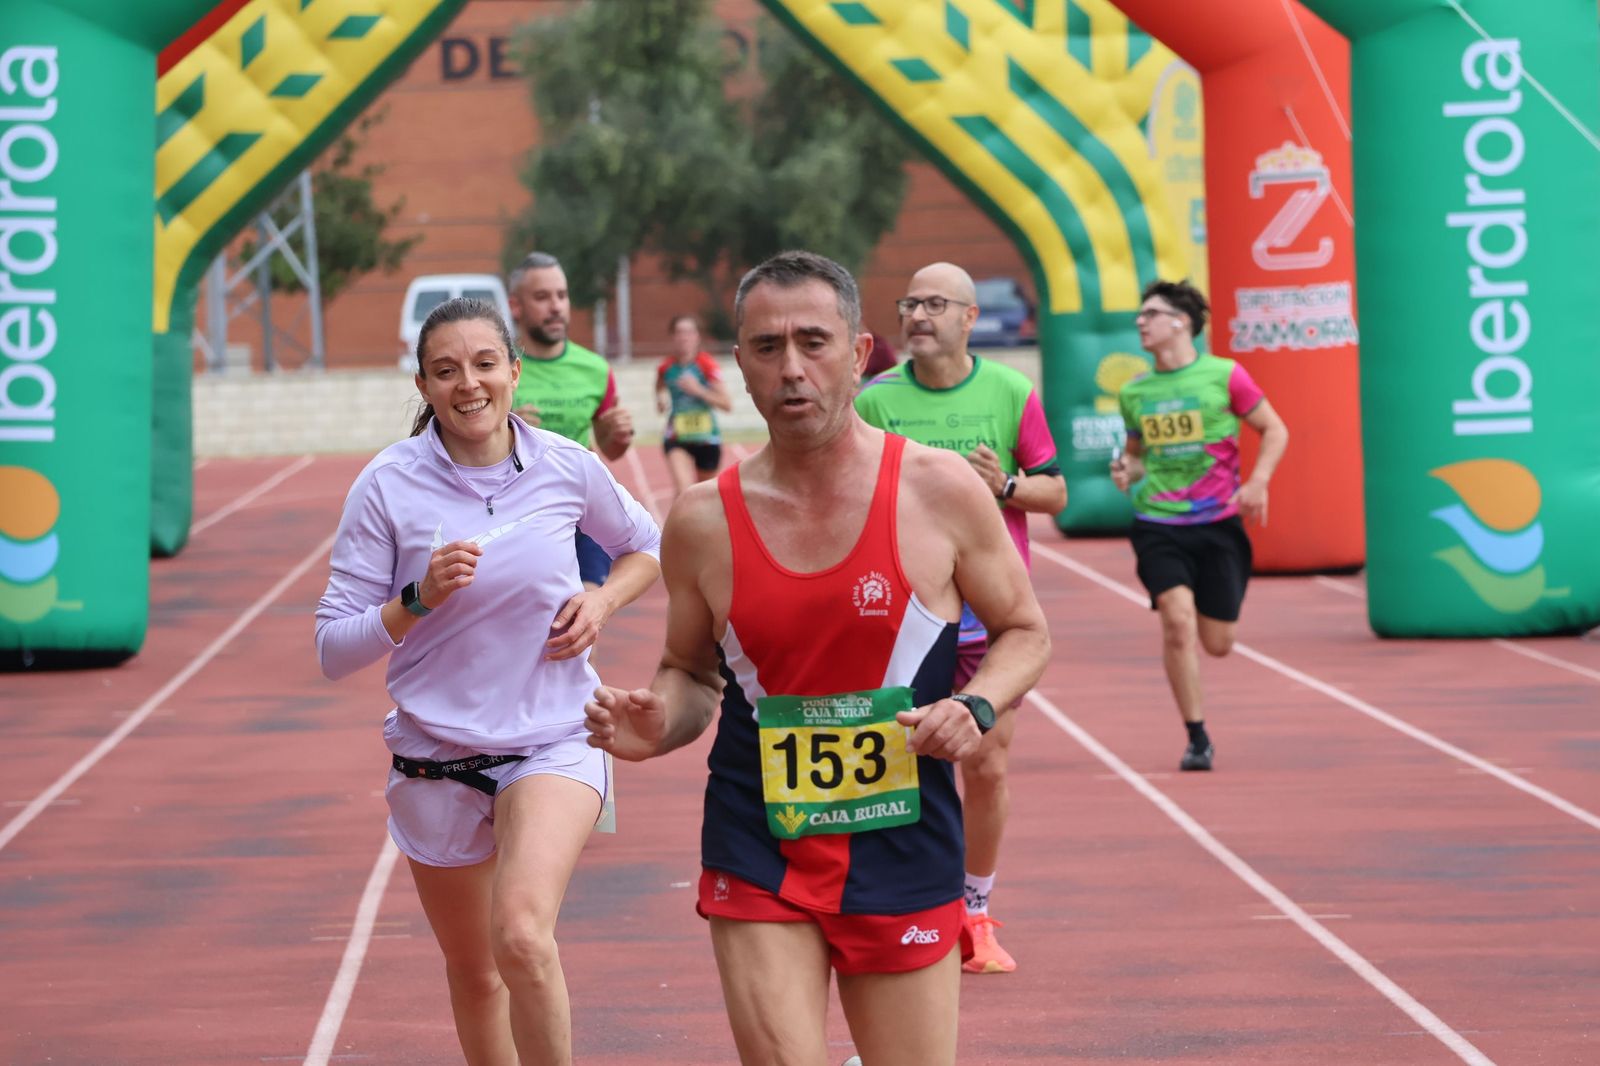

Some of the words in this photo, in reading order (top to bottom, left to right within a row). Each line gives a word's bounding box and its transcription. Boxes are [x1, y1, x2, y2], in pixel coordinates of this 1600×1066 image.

[0, 45, 59, 442] Iberdrola
[1442, 37, 1533, 435] Iberdrola
[1231, 318, 1359, 352] ZAMORA
[1144, 414, 1193, 439] 339
[803, 707, 832, 718] CAJA
[834, 707, 874, 718] RURAL
[773, 731, 887, 790] 153
[809, 808, 853, 826] CAJA
[854, 801, 912, 822] RURAL
[908, 928, 940, 944] asics
